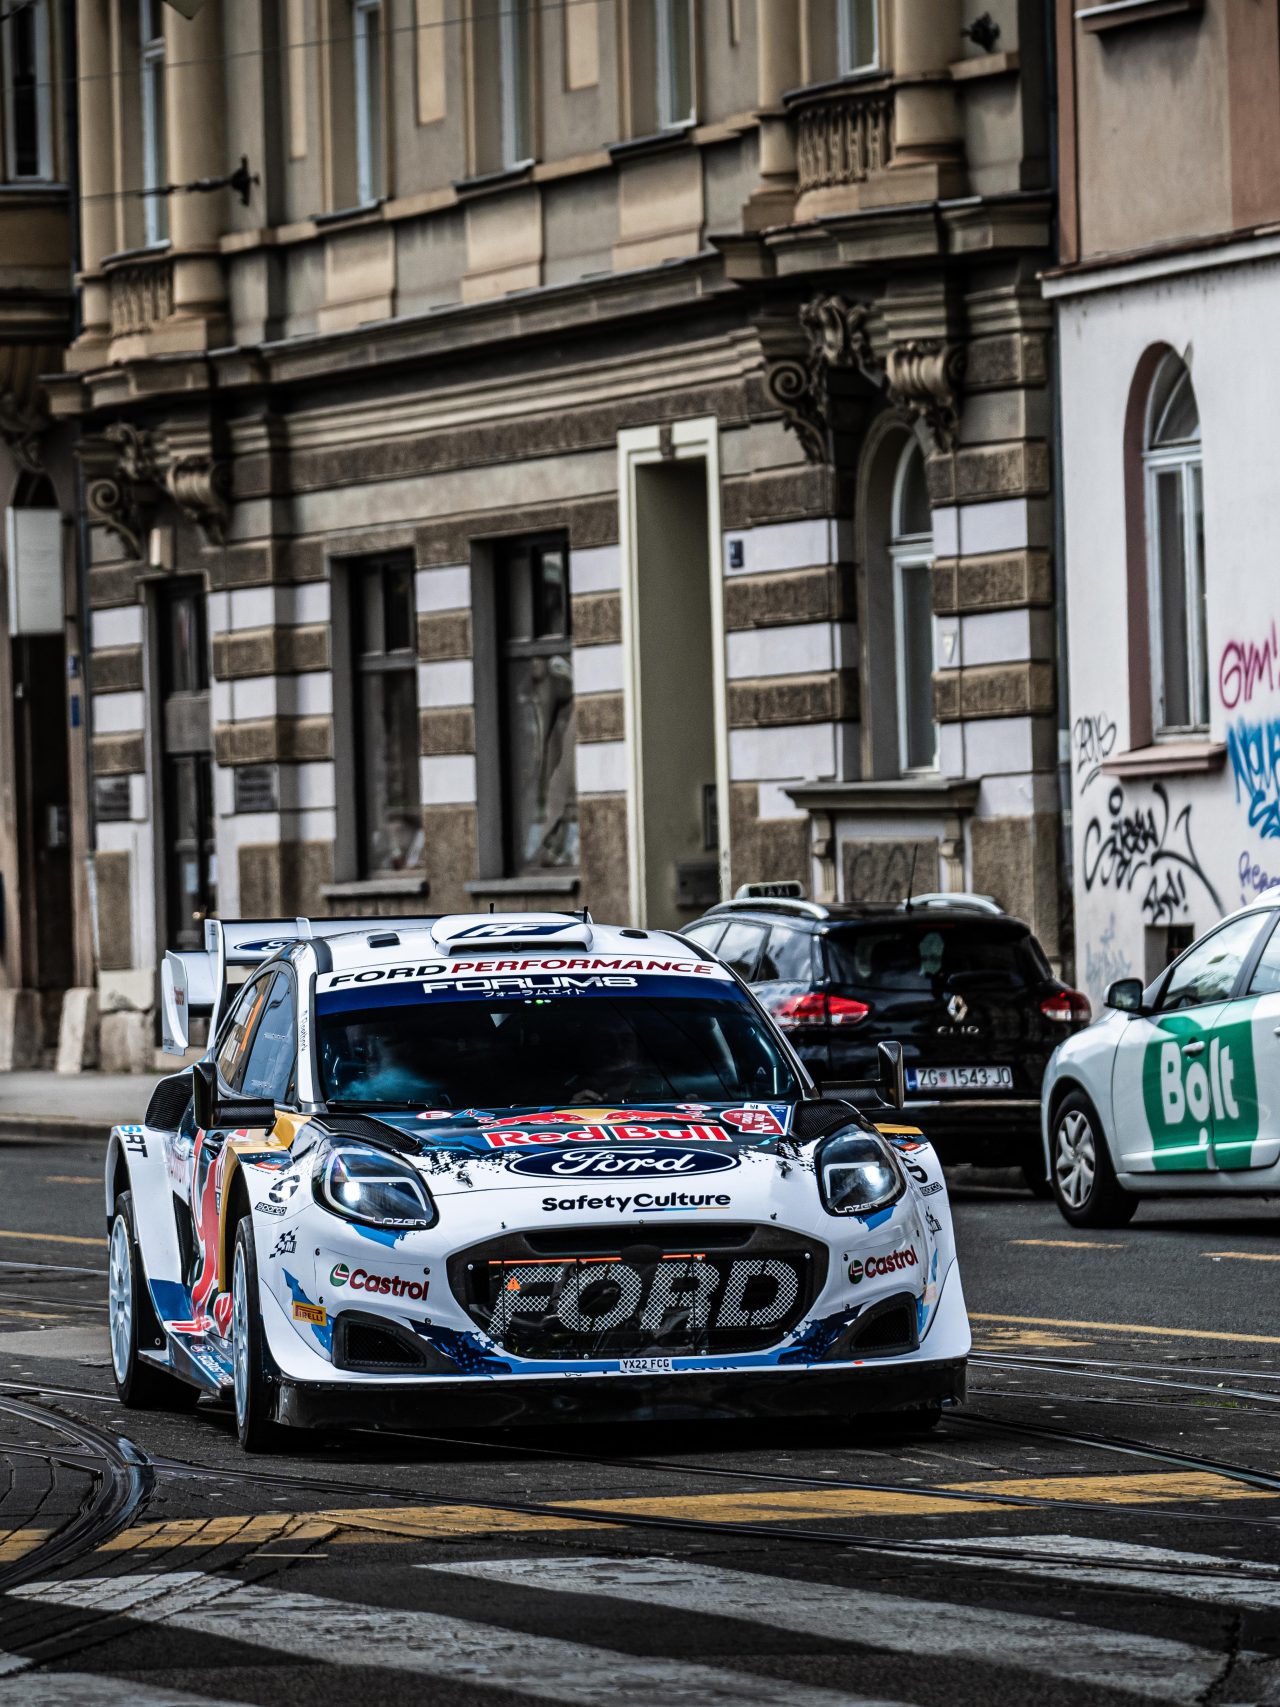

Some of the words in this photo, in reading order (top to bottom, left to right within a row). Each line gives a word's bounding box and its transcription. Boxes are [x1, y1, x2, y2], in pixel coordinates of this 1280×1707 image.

[329, 965, 447, 988] FORD
[451, 959, 714, 975] PERFORMANCE
[423, 976, 638, 995] FORUM8
[937, 1025, 980, 1035] CLIO
[918, 1068, 938, 1086] ZG
[1160, 1037, 1239, 1125] Bolt
[483, 1126, 610, 1148] Red
[609, 1124, 732, 1143] Bull
[552, 1148, 695, 1175] Ford
[257, 1202, 286, 1215] sparco
[373, 1216, 427, 1226] LAZER
[864, 1244, 919, 1279] Castrol
[349, 1268, 430, 1302] Castrol
[488, 1259, 799, 1335] FORD
[295, 1304, 324, 1322] PIRELLI
[622, 1360, 647, 1369] YX22
[651, 1359, 670, 1368] FCG
